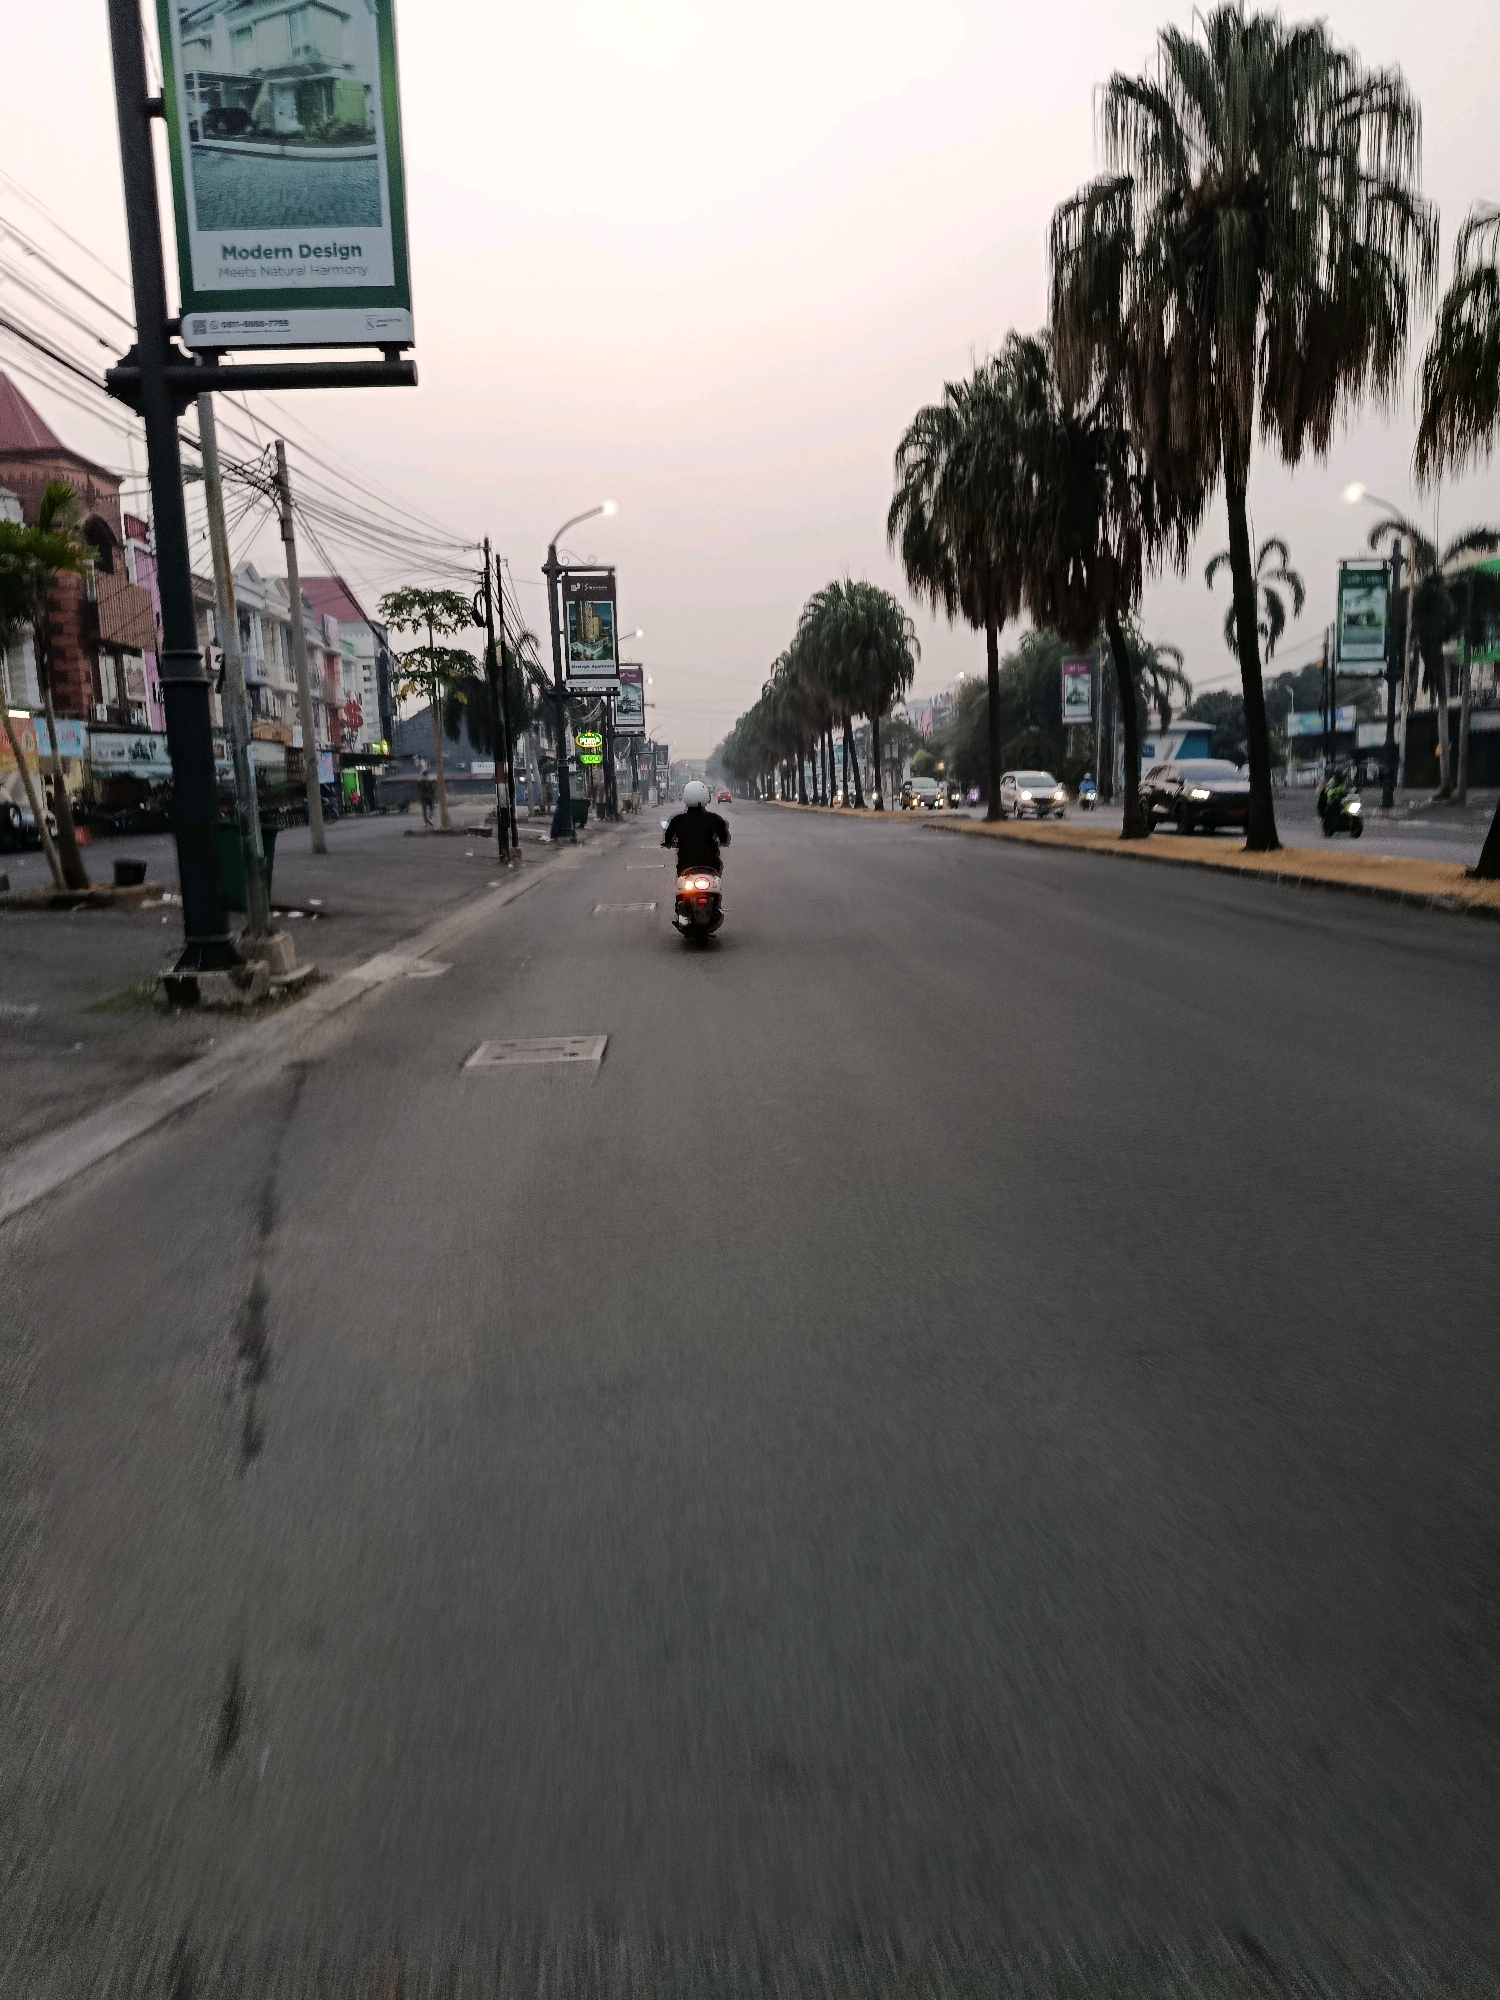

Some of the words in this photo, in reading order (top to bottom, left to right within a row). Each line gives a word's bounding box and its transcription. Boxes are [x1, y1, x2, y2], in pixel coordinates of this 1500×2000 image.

[221, 243, 293, 261] Modern
[298, 242, 363, 260] Design
[218, 266, 257, 279] Meets
[260, 264, 306, 278] Natural
[310, 263, 368, 278] Harmony
